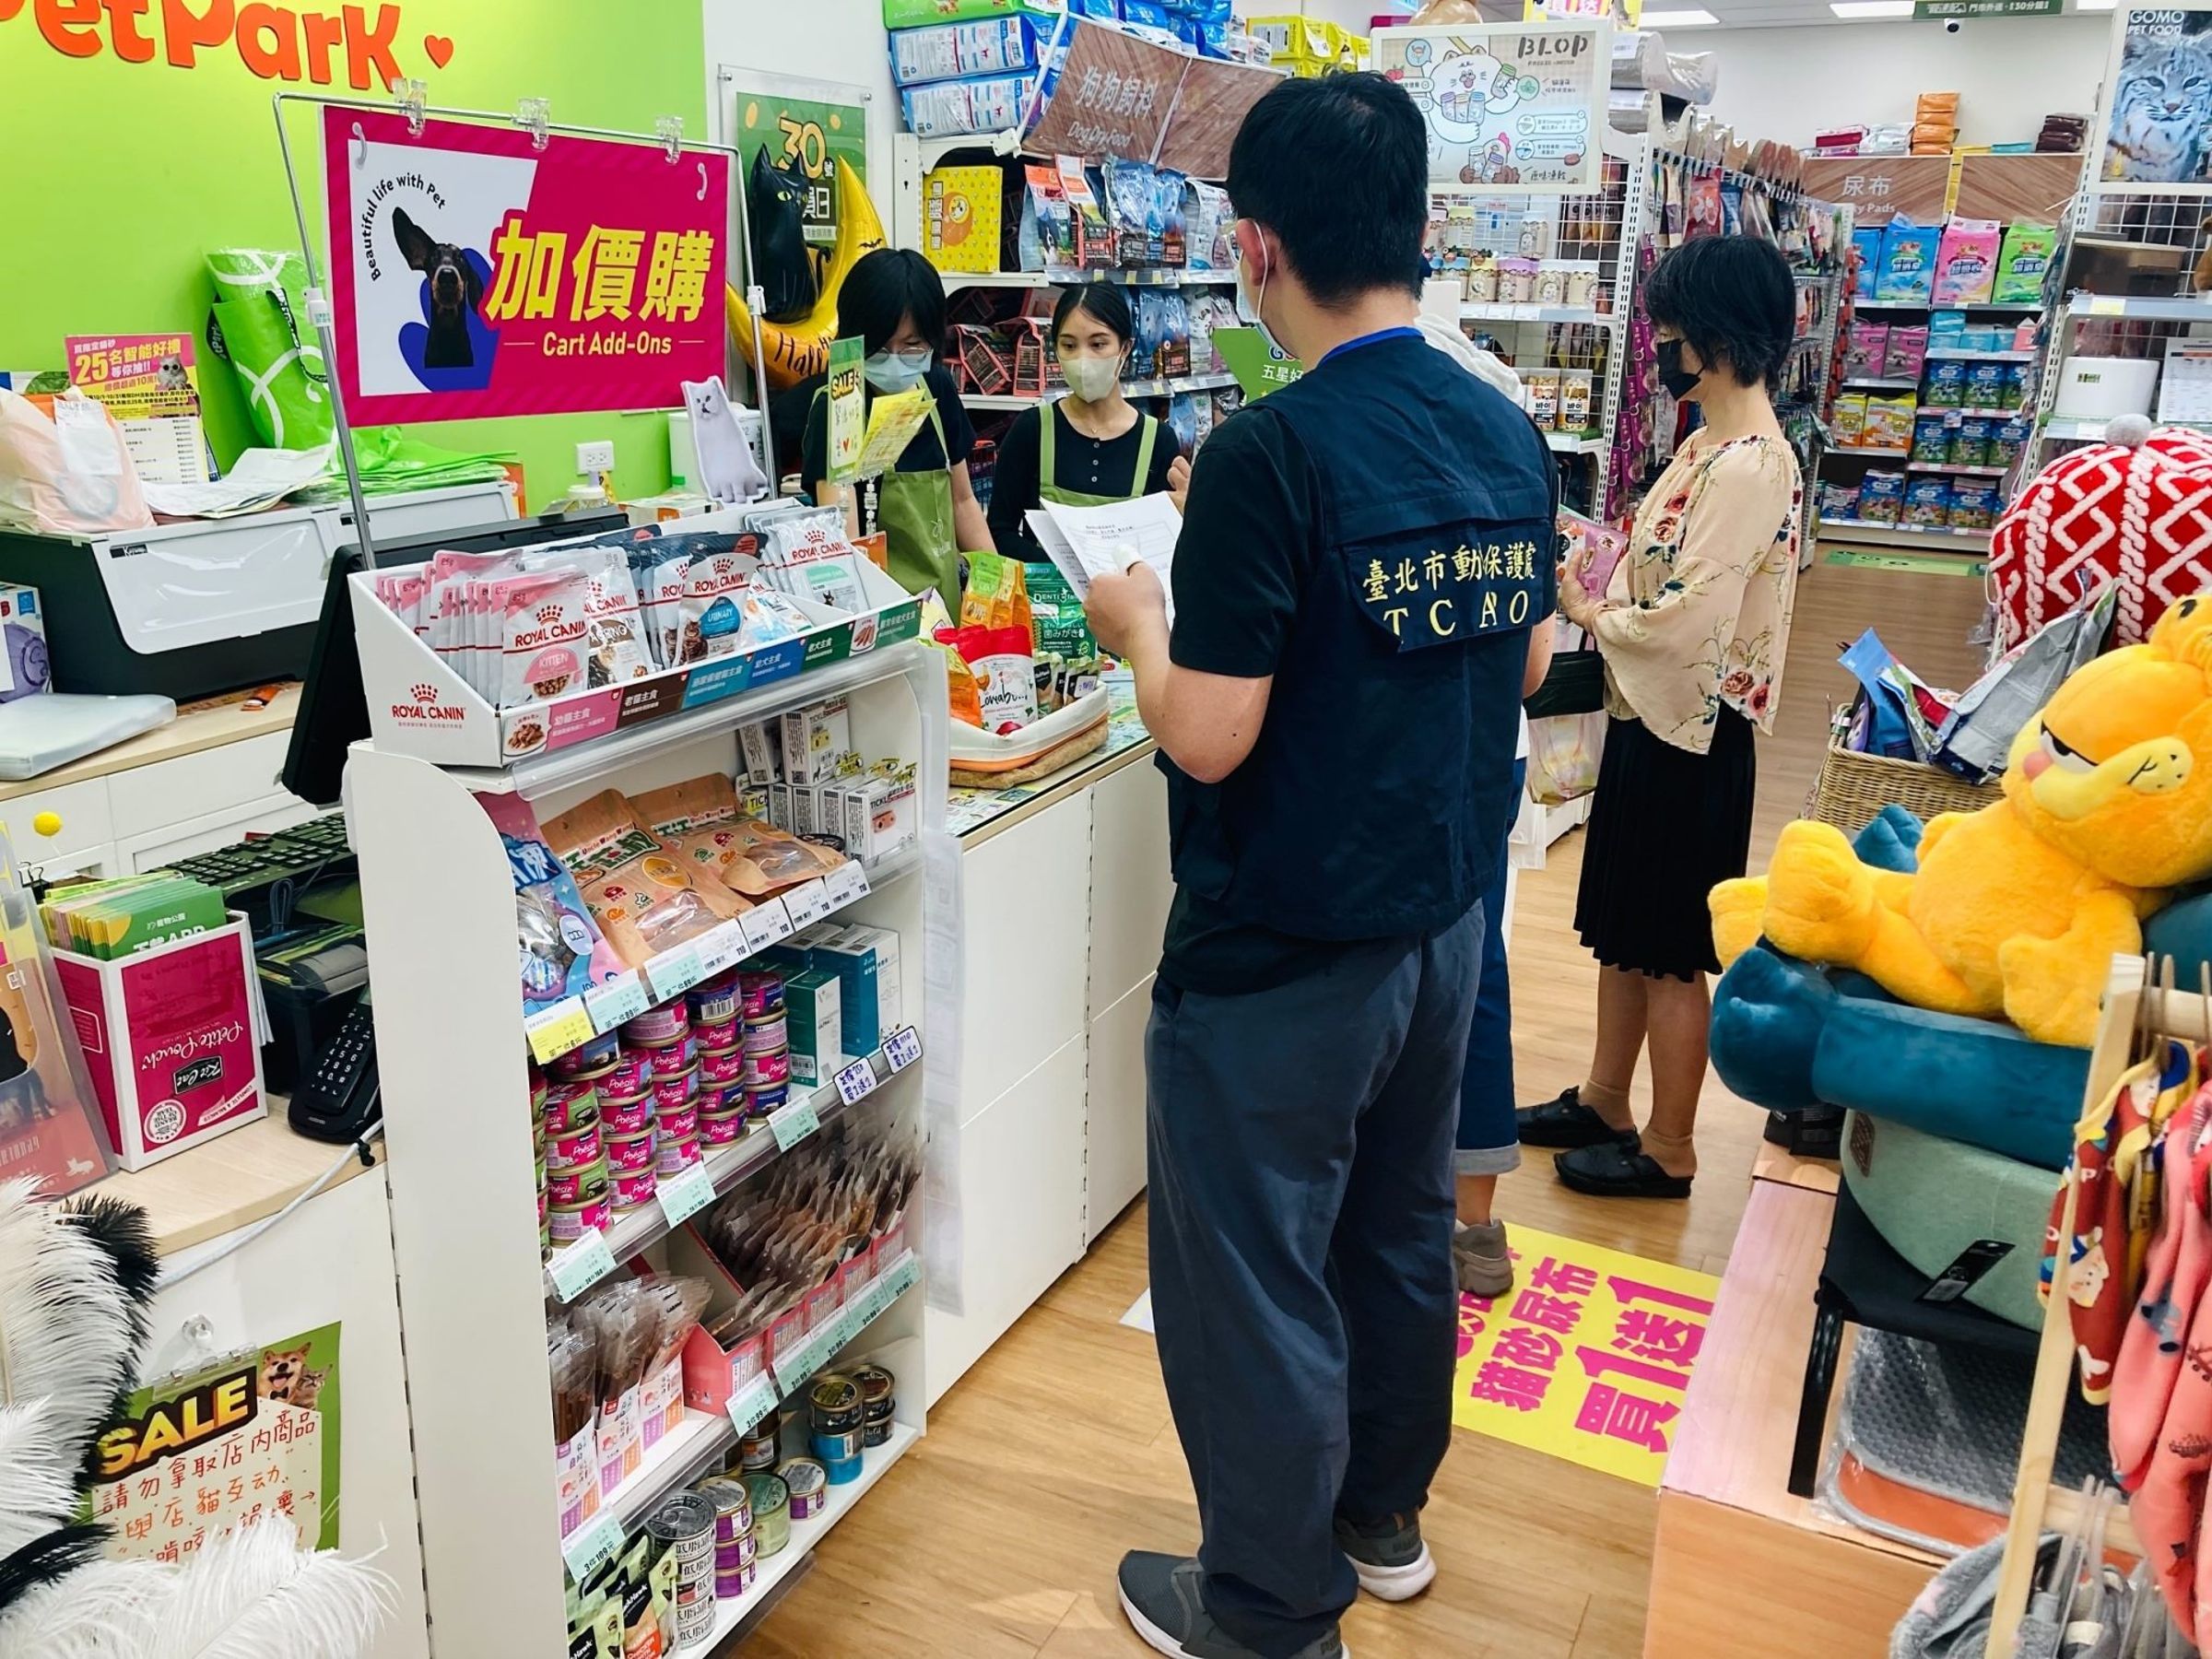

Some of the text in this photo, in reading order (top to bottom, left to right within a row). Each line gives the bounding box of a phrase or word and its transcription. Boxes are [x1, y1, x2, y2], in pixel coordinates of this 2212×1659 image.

[2126, 25, 2183, 36] PET FOOD
[2130, 9, 2185, 25] GOMO
[1517, 35, 1588, 60] BLOP
[1075, 65, 1159, 120] 狗狗飼料
[1842, 175, 1892, 197] 尿布
[1867, 203, 1896, 214] Pads
[361, 171, 446, 282] Beautiful life with Pet
[485, 218, 715, 324] 加價購
[542, 330, 672, 357] Cart Add-Ons
[75, 354, 109, 385] 25
[830, 368, 856, 401] SALE
[719, 572, 746, 587] CANIN
[514, 630, 550, 647] ROYAL
[538, 653, 569, 668] KITTEN
[392, 705, 465, 720] ROYAL CANIN
[144, 1020, 244, 1071] Petite Pouch
[177, 1058, 223, 1091] Kit Cat
[1470, 1255, 1599, 1412] 貓砂尿布
[1574, 1275, 1715, 1453] 買1送1
[97, 1375, 249, 1476] SALE
